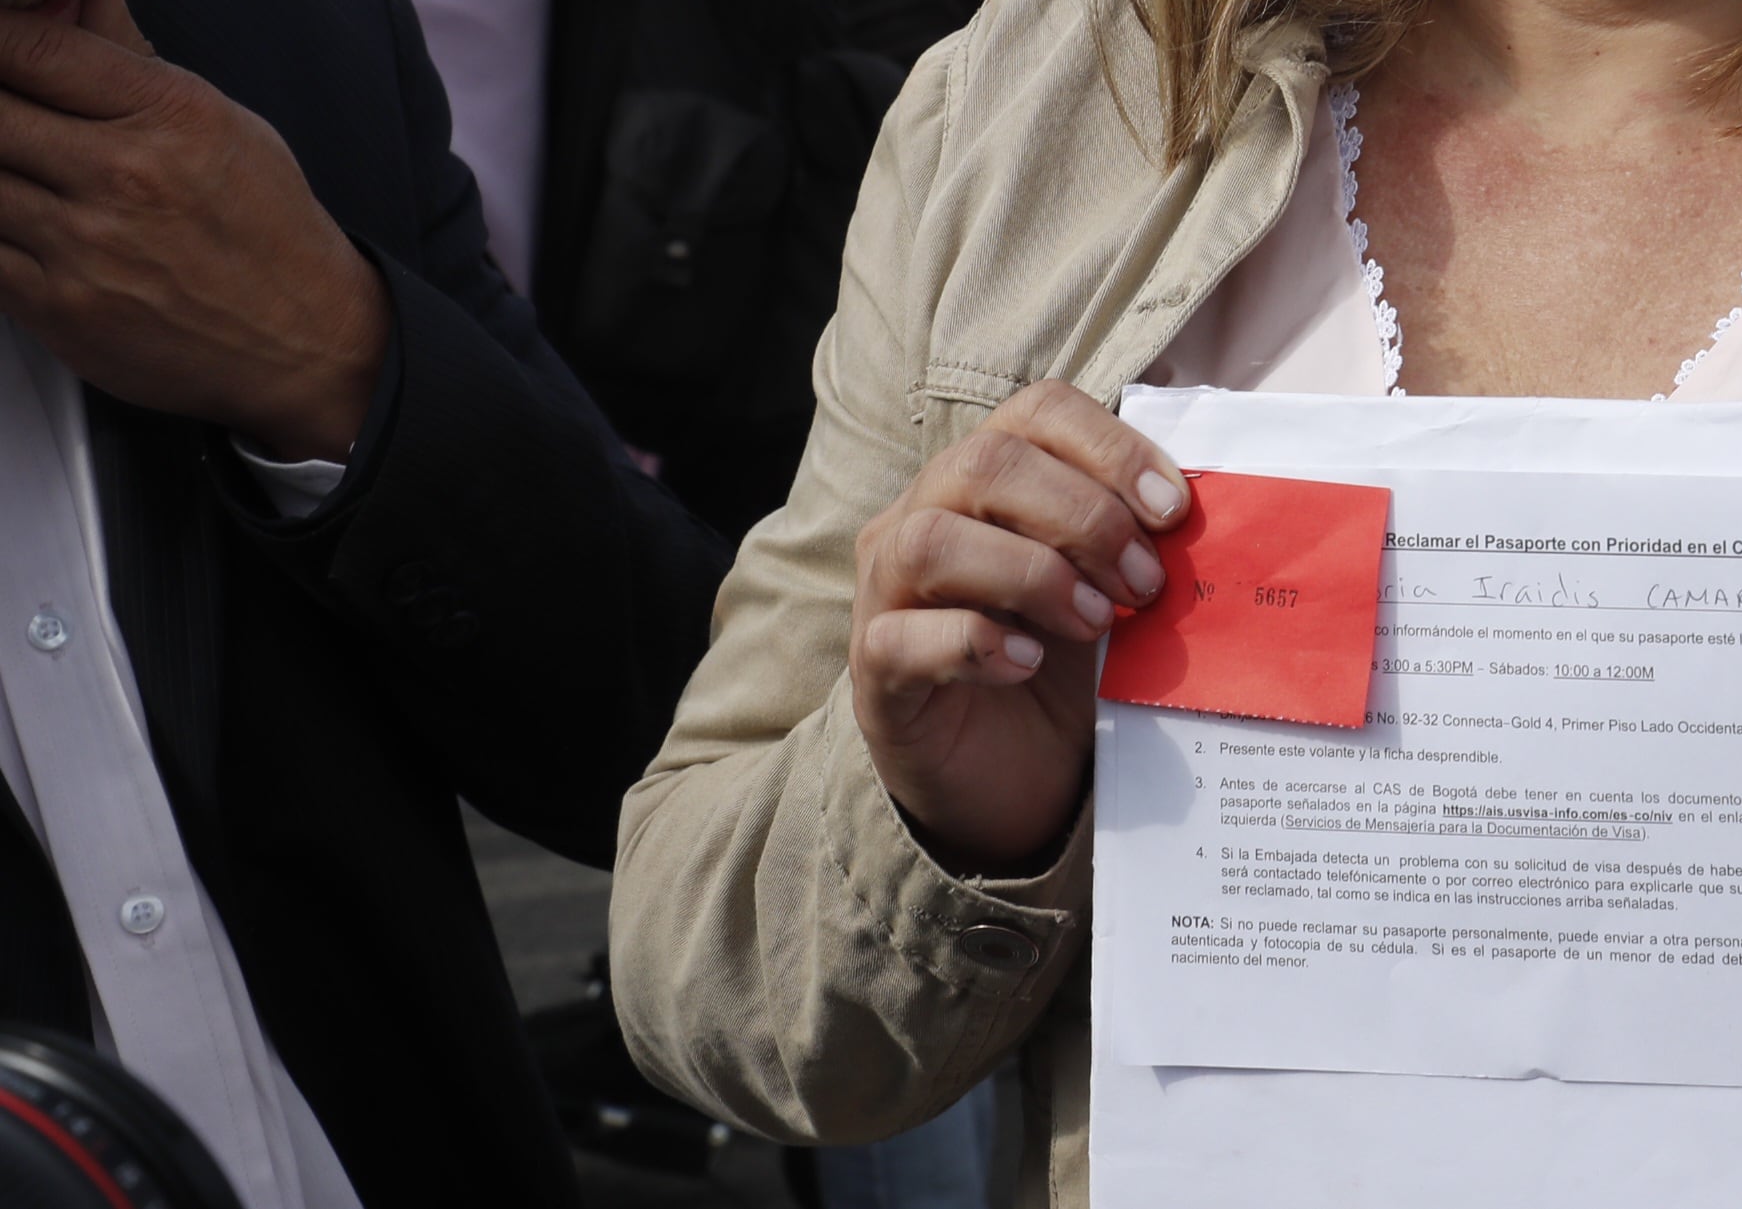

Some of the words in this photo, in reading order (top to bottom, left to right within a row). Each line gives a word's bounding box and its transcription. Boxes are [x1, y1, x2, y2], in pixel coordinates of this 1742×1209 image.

[1386, 531, 1462, 549] Reclamar
[1464, 533, 1479, 549] el
[1484, 533, 1566, 554] Pasaporte
[1570, 539, 1600, 552] con
[1606, 536, 1682, 553] Prioridad
[1686, 541, 1707, 554] en
[1712, 538, 1726, 554] el
[1254, 587, 1299, 608] 5657
[1392, 623, 1474, 640] informándole
[1477, 625, 1488, 640] el
[1492, 626, 1552, 641] momento
[1555, 630, 1572, 642] en
[1575, 627, 1587, 642] el
[1590, 631, 1615, 646] que
[1618, 632, 1634, 643] su
[1638, 630, 1704, 648] pasaporte
[1707, 630, 1735, 645] esté
[1382, 658, 1410, 673] 3:00
[1412, 662, 1421, 673] a
[1424, 659, 1473, 675] 5:30PM
[1488, 660, 1548, 677] Sábados:
[1554, 662, 1589, 678] 10:00
[1592, 666, 1601, 678] a
[1606, 663, 1654, 679] 12:00M
[1376, 710, 1398, 725] No.
[1402, 711, 1438, 727] 92-32
[1544, 715, 1557, 732] 4,
[1561, 716, 1604, 732] Primer
[1608, 717, 1637, 733] Piso
[1640, 718, 1674, 734] Lado
[1194, 739, 1206, 755] 2.
[1219, 740, 1275, 757] Presente
[1278, 743, 1305, 758] este
[1308, 743, 1354, 759] volante
[1358, 748, 1366, 763] y
[1369, 745, 1380, 760] la
[1383, 746, 1413, 761] ficha
[1416, 747, 1502, 767] desprendible.
[1194, 775, 1206, 790] 3.
[1219, 776, 1255, 791] Antes
[1262, 777, 1278, 792] de
[1284, 781, 1347, 794] acercarse
[1354, 780, 1365, 795] al
[1372, 781, 1401, 796] CAS
[1408, 782, 1424, 797] de
[1432, 783, 1478, 802] Bogotá
[1484, 785, 1517, 800] debe
[1524, 787, 1558, 802] tener
[1564, 791, 1582, 802] en
[1588, 789, 1633, 804] cuenta
[1640, 789, 1660, 805] los
[1220, 795, 1282, 814] pasaporte
[1286, 796, 1350, 813] señalados
[1355, 802, 1372, 814] en
[1377, 799, 1388, 814] la
[1393, 800, 1436, 819] página
[1442, 803, 1672, 823] https://ais.usvisa-info.com/es-co/niv
[1678, 811, 1695, 823] en
[1700, 808, 1712, 823] el
[1220, 811, 1276, 831] izquierda
[1280, 814, 1342, 834] (Servicios
[1344, 816, 1360, 832] de
[1438, 823, 1468, 838] para
[1472, 821, 1484, 836] la
[1486, 821, 1588, 839] Documentación
[1590, 824, 1608, 839] de
[1612, 825, 1650, 843] Visa).
[1195, 845, 1207, 860] 4.
[1220, 846, 1233, 861] Si
[1238, 846, 1249, 861] la
[1254, 847, 1318, 867] Embajada
[1322, 849, 1368, 866] detecta
[1373, 855, 1390, 867] un
[1399, 852, 1459, 872] problema
[1464, 858, 1488, 870] con
[1493, 859, 1508, 871] su
[1514, 856, 1566, 873] solicitud
[1572, 858, 1589, 873] de
[1594, 859, 1621, 874] visa
[1625, 860, 1682, 879] después
[1687, 861, 1704, 877] de
[1220, 864, 1248, 879] será
[1252, 865, 1322, 882] contactado
[1326, 867, 1427, 886] telefónicamente
[1431, 875, 1440, 886] o
[1445, 875, 1467, 890] por
[1471, 876, 1513, 889] correo
[1518, 874, 1590, 891] electrónico
[1594, 880, 1624, 895] para
[1629, 878, 1693, 897] explicarle
[1698, 883, 1724, 898] que
[1171, 914, 1214, 930] NOTA:
[1219, 916, 1232, 931] Si
[1237, 920, 1254, 932] no
[1258, 917, 1298, 936] puede
[1302, 919, 1358, 936] reclamar
[1362, 925, 1378, 937] su
[1382, 923, 1446, 942] pasaporte
[1451, 925, 1552, 946] personalmente,
[1557, 928, 1598, 947] puede
[1603, 930, 1644, 946] enviar
[1649, 935, 1658, 946] a
[1662, 933, 1688, 947] otra
